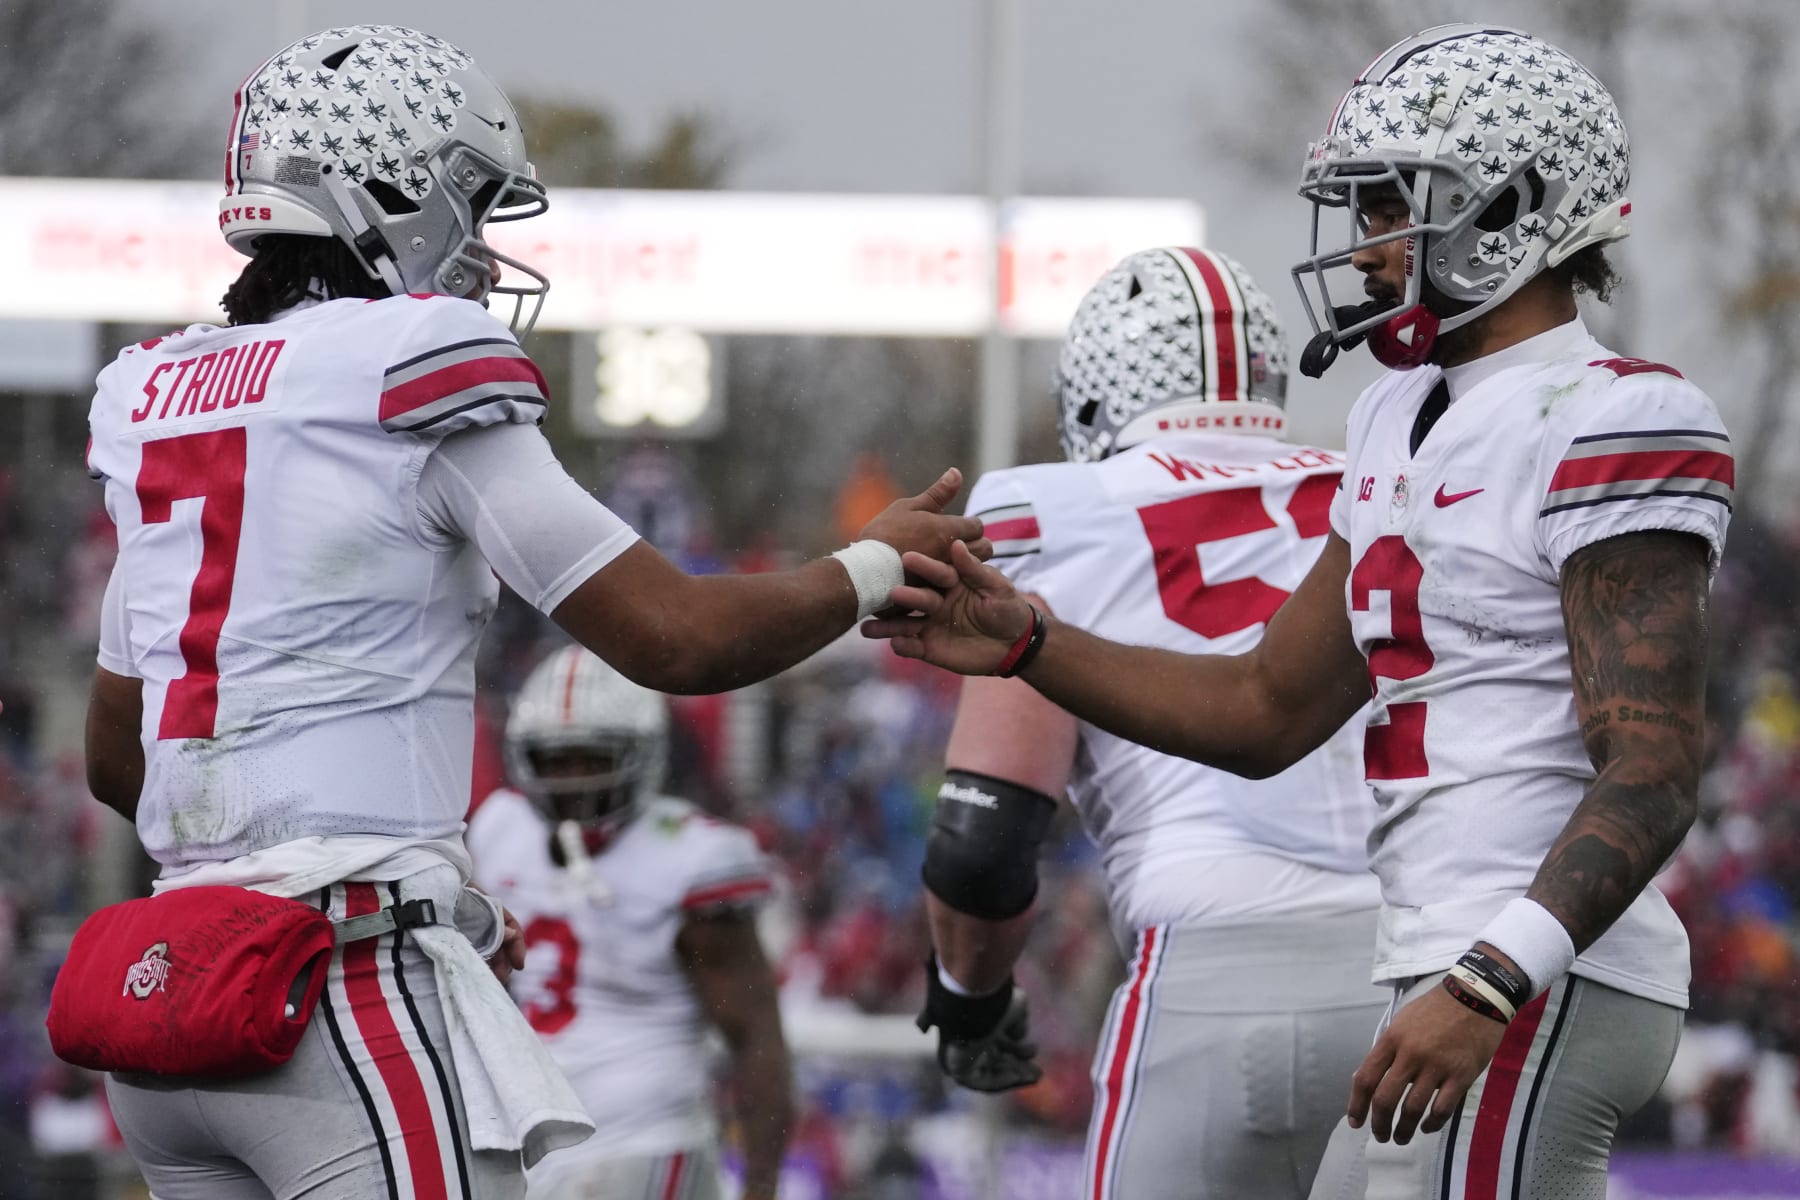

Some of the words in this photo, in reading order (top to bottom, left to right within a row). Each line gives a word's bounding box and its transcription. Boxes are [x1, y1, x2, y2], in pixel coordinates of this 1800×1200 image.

[245, 154, 252, 170] 7
[131, 339, 285, 423] STROUD
[1158, 414, 1284, 430] BUCKEYES
[136, 426, 246, 740] 7
[1351, 534, 1435, 780] 2
[523, 914, 580, 1035] 3
